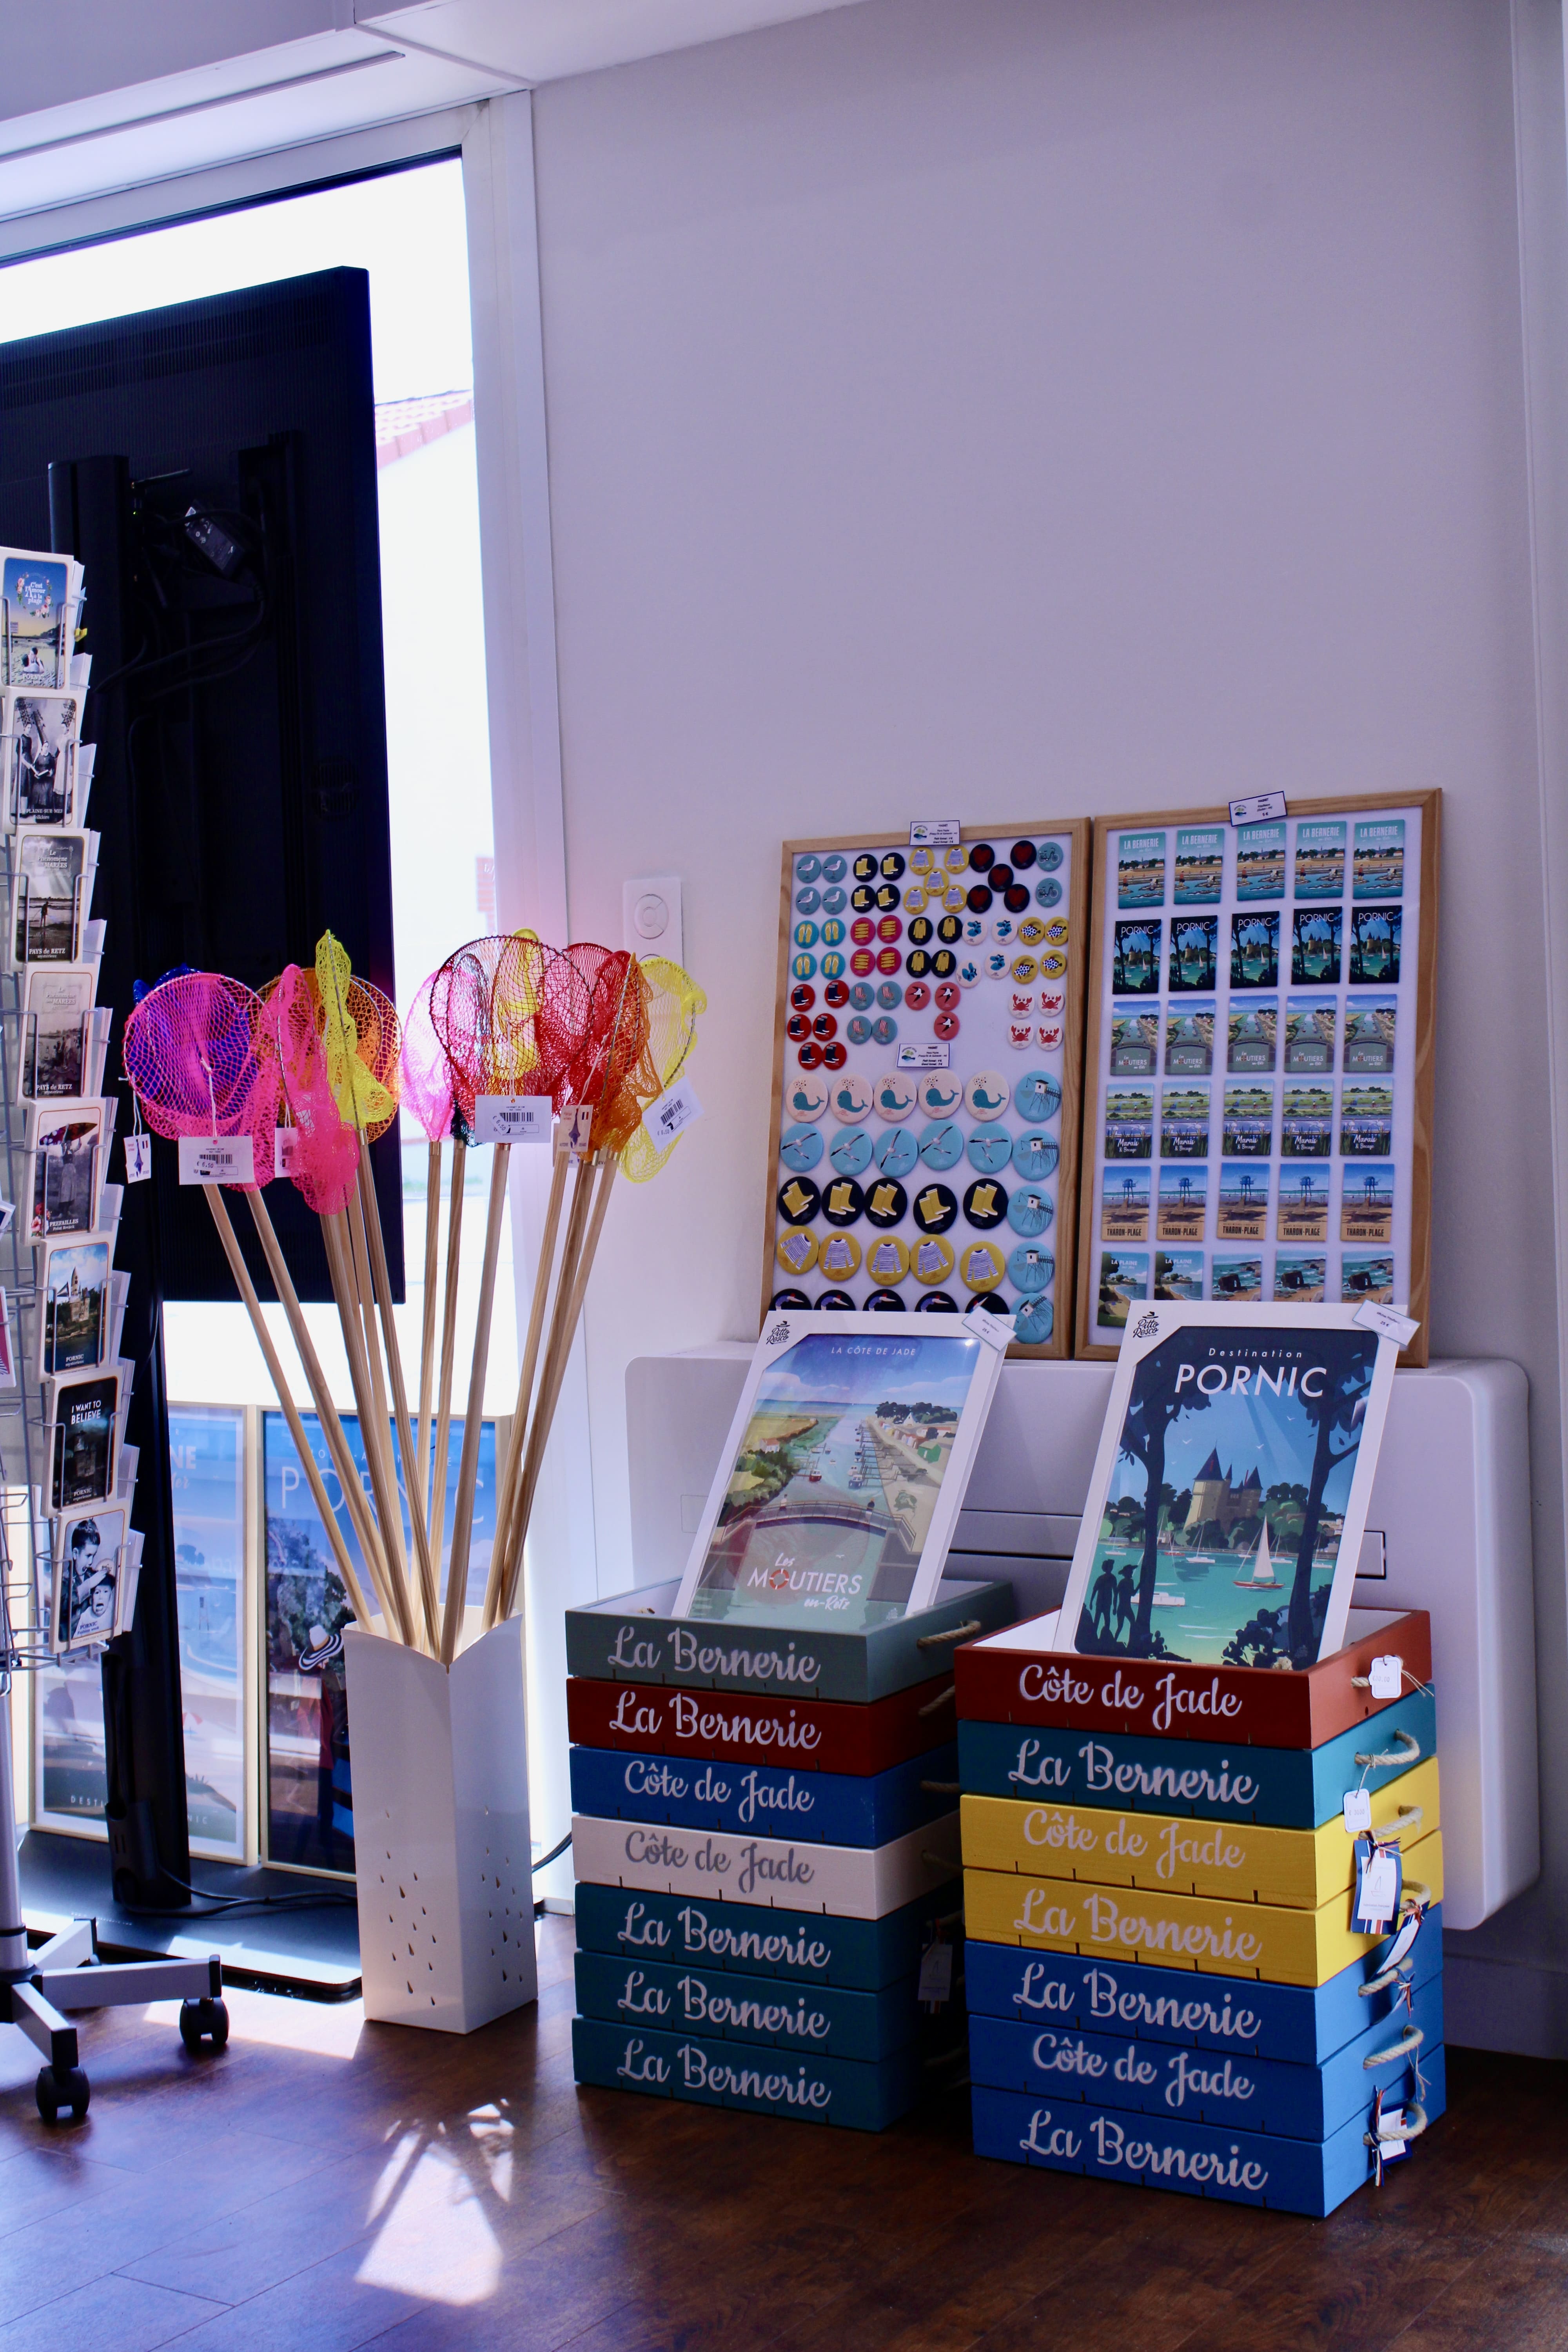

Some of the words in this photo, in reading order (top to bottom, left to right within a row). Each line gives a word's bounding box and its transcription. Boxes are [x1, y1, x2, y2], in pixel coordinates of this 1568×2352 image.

[1243, 831, 1250, 840] LA
[1252, 828, 1279, 839] BERNERIE
[1303, 829, 1310, 838] LA
[1311, 827, 1339, 837] BERNERIE
[1360, 828, 1368, 837] LA
[1369, 826, 1398, 837] BERNERIE
[1124, 840, 1131, 850] LA
[1132, 838, 1159, 849] BERNERIE
[1182, 835, 1189, 845] LA
[1190, 834, 1218, 844] BERNERIE
[1238, 918, 1272, 928] PORNIC
[1300, 913, 1334, 923] PORNIC
[1358, 912, 1394, 922] PORNIC
[1121, 926, 1154, 935] PORNIC
[1177, 922, 1210, 932] PORNIC
[496, 1120, 506, 1131] 6.50
[1117, 1139, 1139, 1147] Marais
[1173, 1137, 1194, 1146] Marais
[1294, 1136, 1318, 1144] Marais
[1353, 1135, 1377, 1143] Marais
[49, 1219, 78, 1227] PREFAILLES
[1138, 1319, 1159, 1328] Pitto
[772, 1327, 790, 1336] Pitto
[1132, 1328, 1159, 1338] Resco
[766, 1334, 789, 1345] Resco
[847, 1345, 872, 1355] CÔTE
[1208, 1347, 1302, 1359] Destination
[1174, 1364, 1327, 1397] PORNIC
[76, 1402, 92, 1412] WANT
[93, 1400, 101, 1408] TO
[71, 1409, 101, 1425] BELIEVE
[74, 1488, 92, 1496] PORNIC
[775, 1552, 795, 1566] Les
[747, 1568, 862, 1595] MOUTIERS
[804, 1595, 850, 1611] en-Retz
[80, 1621, 98, 1629] PORNIC
[607, 1626, 660, 1668] La
[667, 1626, 821, 1682] Bernerie
[1019, 1664, 1093, 1705] Côte
[1101, 1670, 1144, 1710] de
[1152, 1672, 1242, 1730] Jade
[609, 1690, 662, 1733] La
[669, 1693, 822, 1750] Bernerie
[1008, 1738, 1071, 1786] La
[1078, 1742, 1259, 1805] Bernerie
[625, 1760, 688, 1798] Côte
[694, 1767, 731, 1803] de
[738, 1770, 814, 1823] Jade
[1023, 1809, 1097, 1852] Côte
[1105, 1817, 1147, 1858] de
[1156, 1822, 1245, 1879] Jade
[625, 1830, 688, 1868] Côte
[694, 1838, 731, 1873] de
[738, 1842, 814, 1894] Jade
[1014, 1887, 1075, 1936] La
[1083, 1893, 1262, 1961] Bernerie
[617, 1902, 670, 1946] La
[677, 1906, 831, 1968] Bernerie
[617, 1971, 670, 2014] La
[677, 1975, 831, 2038] Bernerie
[1013, 1962, 1074, 2011] La
[1083, 1967, 1261, 2038] Bernerie
[617, 2039, 670, 2083] La
[677, 2043, 831, 2108] Bernerie
[1033, 2033, 1107, 2078] Côte
[1114, 2045, 1156, 2084] de
[1165, 2052, 1254, 2107] Jade
[1019, 2109, 1082, 2158] La
[1090, 2116, 1268, 2190] Bernerie
